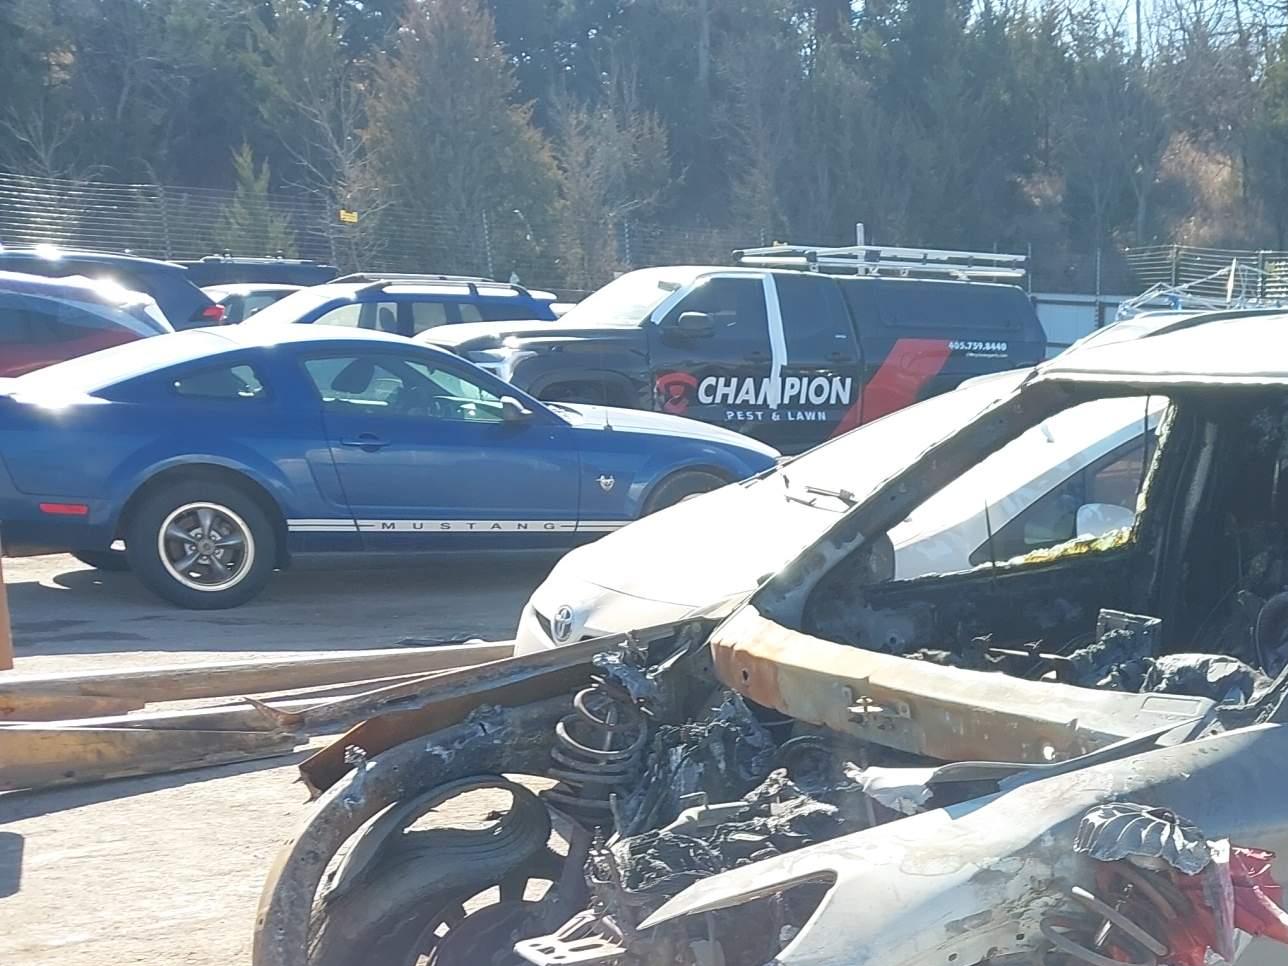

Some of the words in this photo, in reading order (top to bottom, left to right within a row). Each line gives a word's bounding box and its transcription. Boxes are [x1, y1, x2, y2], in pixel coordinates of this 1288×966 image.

[698, 376, 852, 405] CHAMPION
[726, 411, 763, 421] PEST
[771, 411, 781, 422] &
[788, 411, 827, 421] LAWN
[381, 522, 556, 530] MUSTANG
